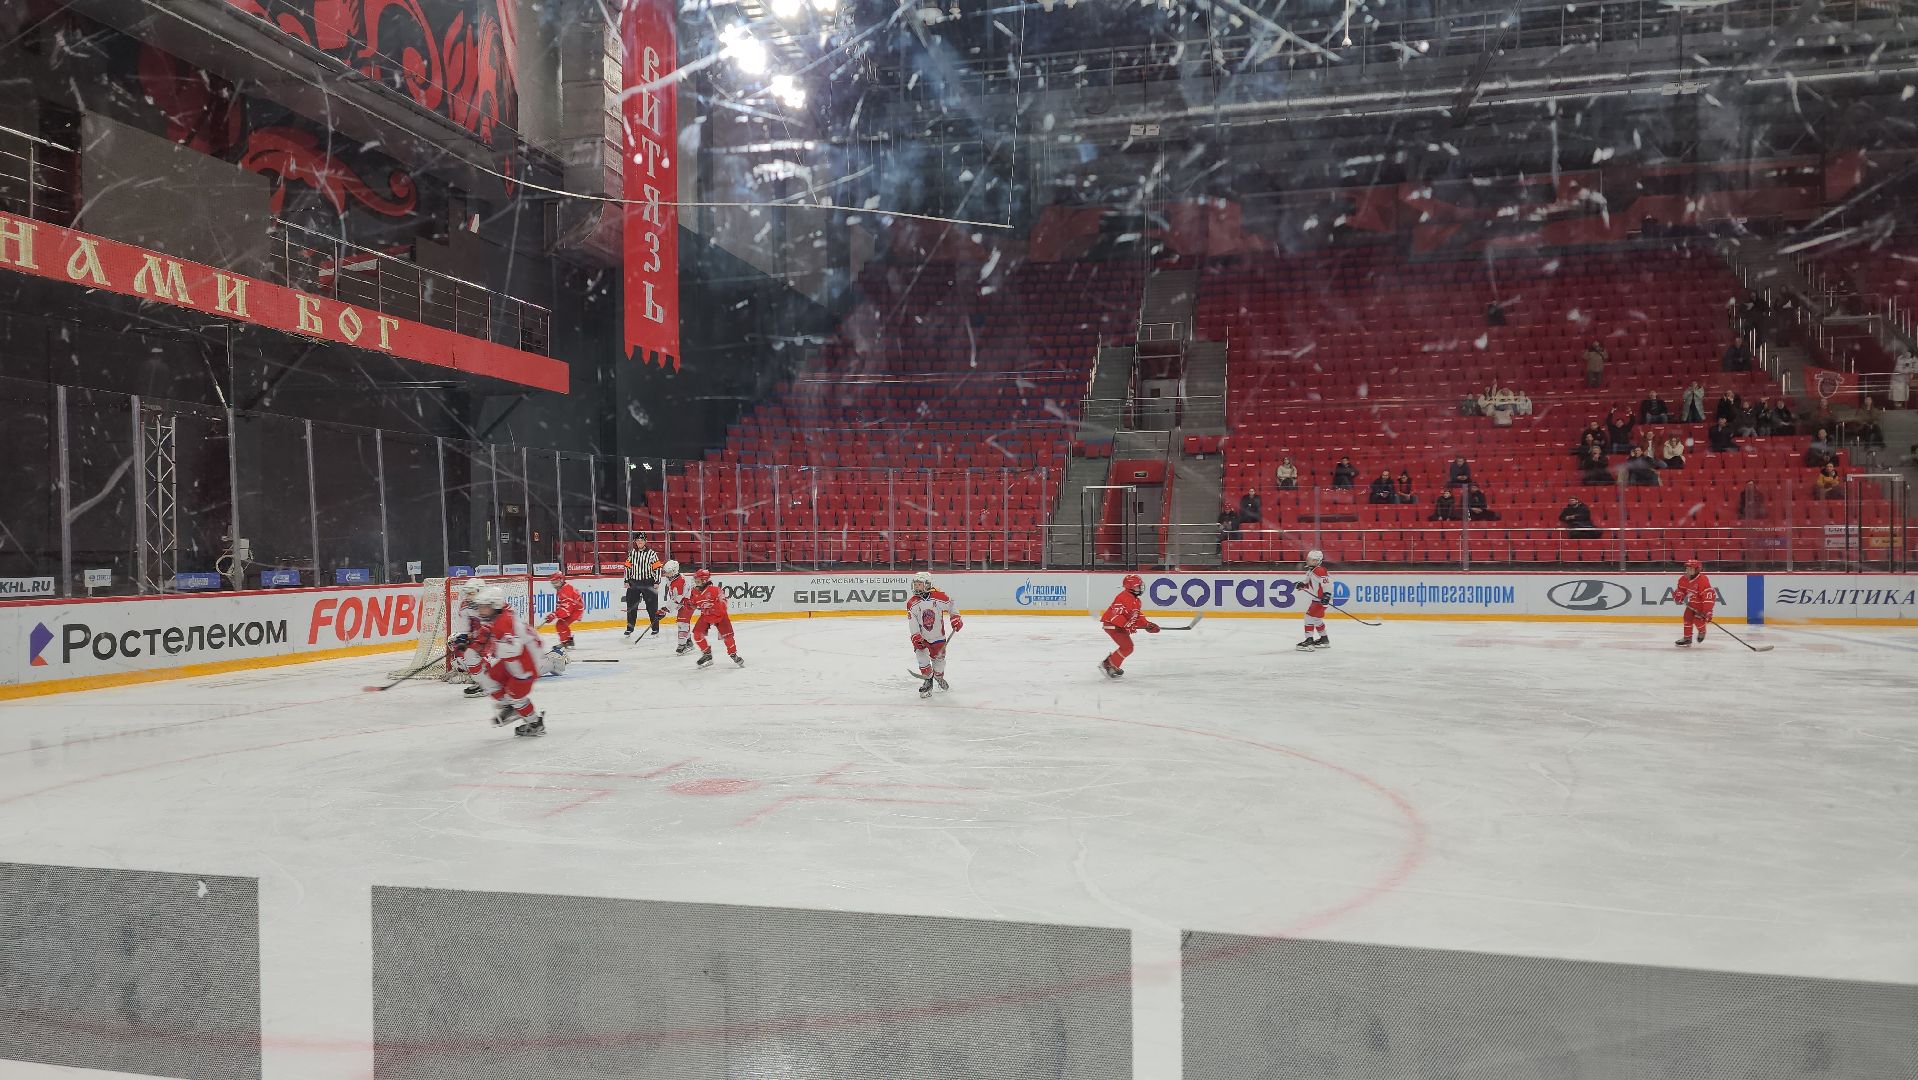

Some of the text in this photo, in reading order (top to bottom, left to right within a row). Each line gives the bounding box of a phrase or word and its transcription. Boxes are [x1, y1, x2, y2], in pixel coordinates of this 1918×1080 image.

[296, 294, 399, 351] БОГ
[793, 589, 908, 604] GISLAVED
[1355, 582, 1515, 607] севернефтегазпром
[1641, 586, 1727, 605] LAA
[1797, 589, 1916, 605] БАЛТИКА
[62, 619, 288, 664] Ростелеком
